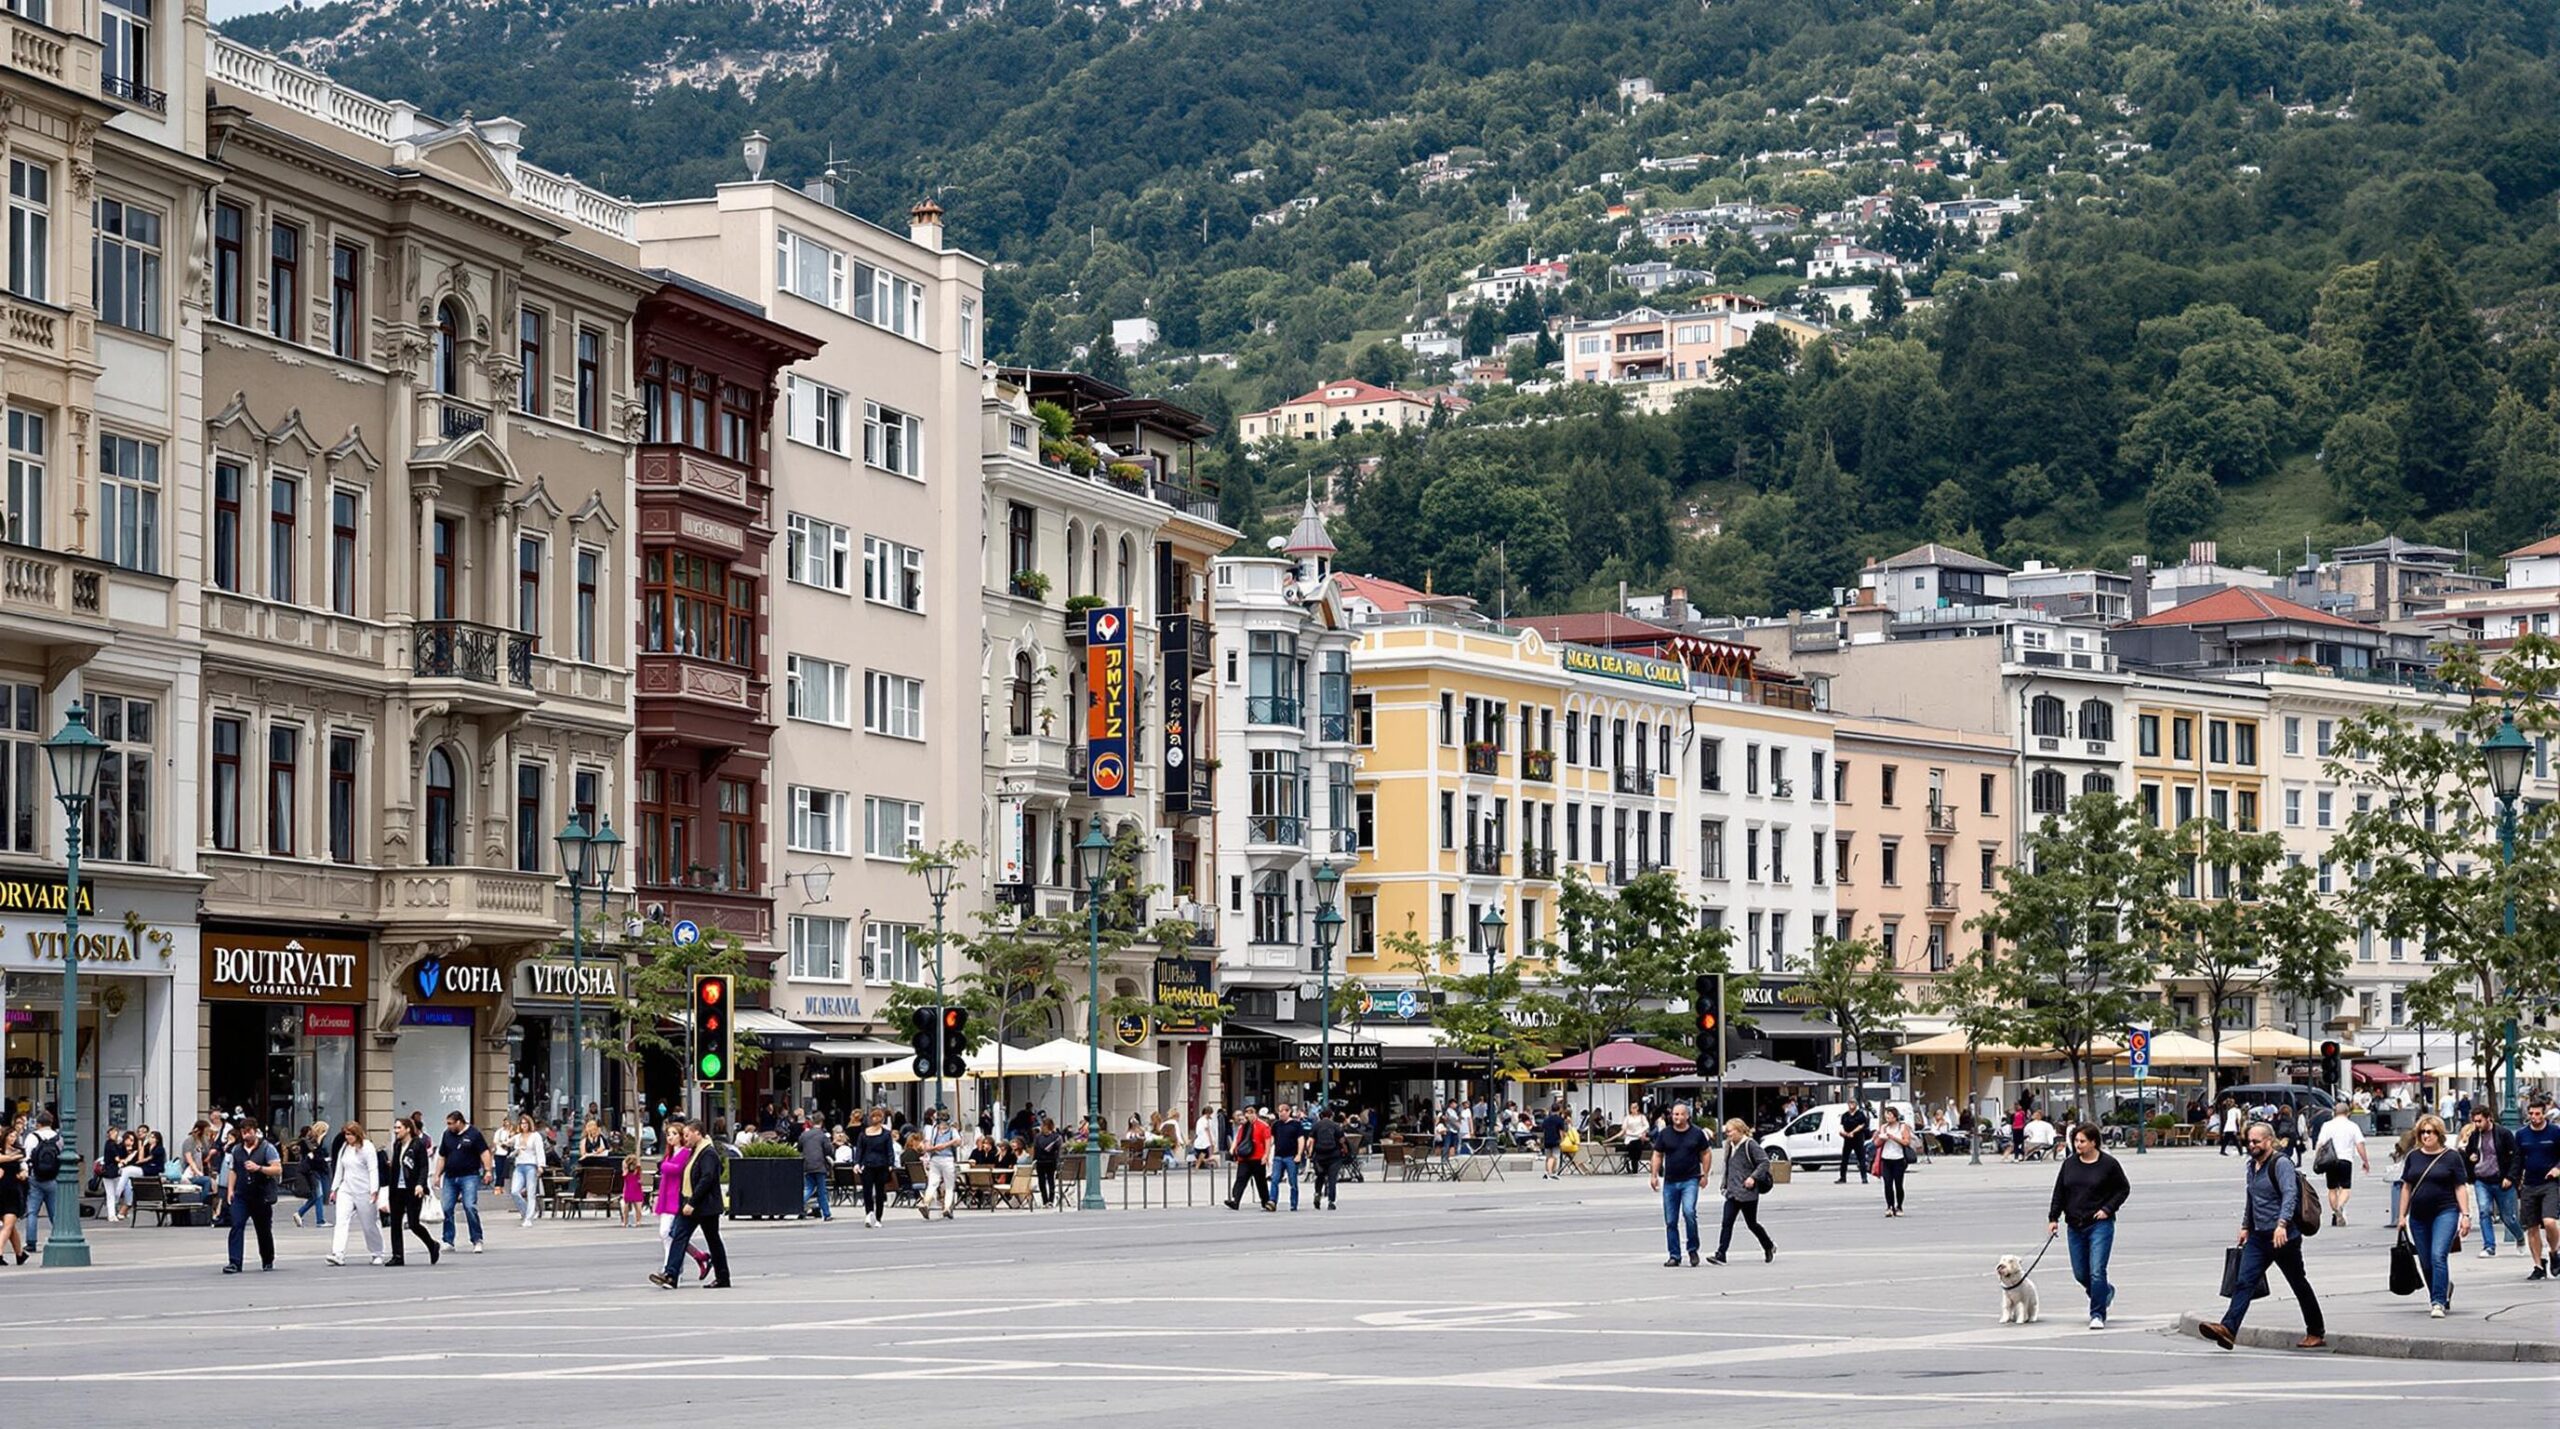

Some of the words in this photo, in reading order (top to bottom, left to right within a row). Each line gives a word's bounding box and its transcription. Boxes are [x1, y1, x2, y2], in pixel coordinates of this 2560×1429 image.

[213, 947, 356, 988] BOUTRVATT
[445, 965, 503, 993] COFIA
[533, 964, 616, 995] VITOSHA
